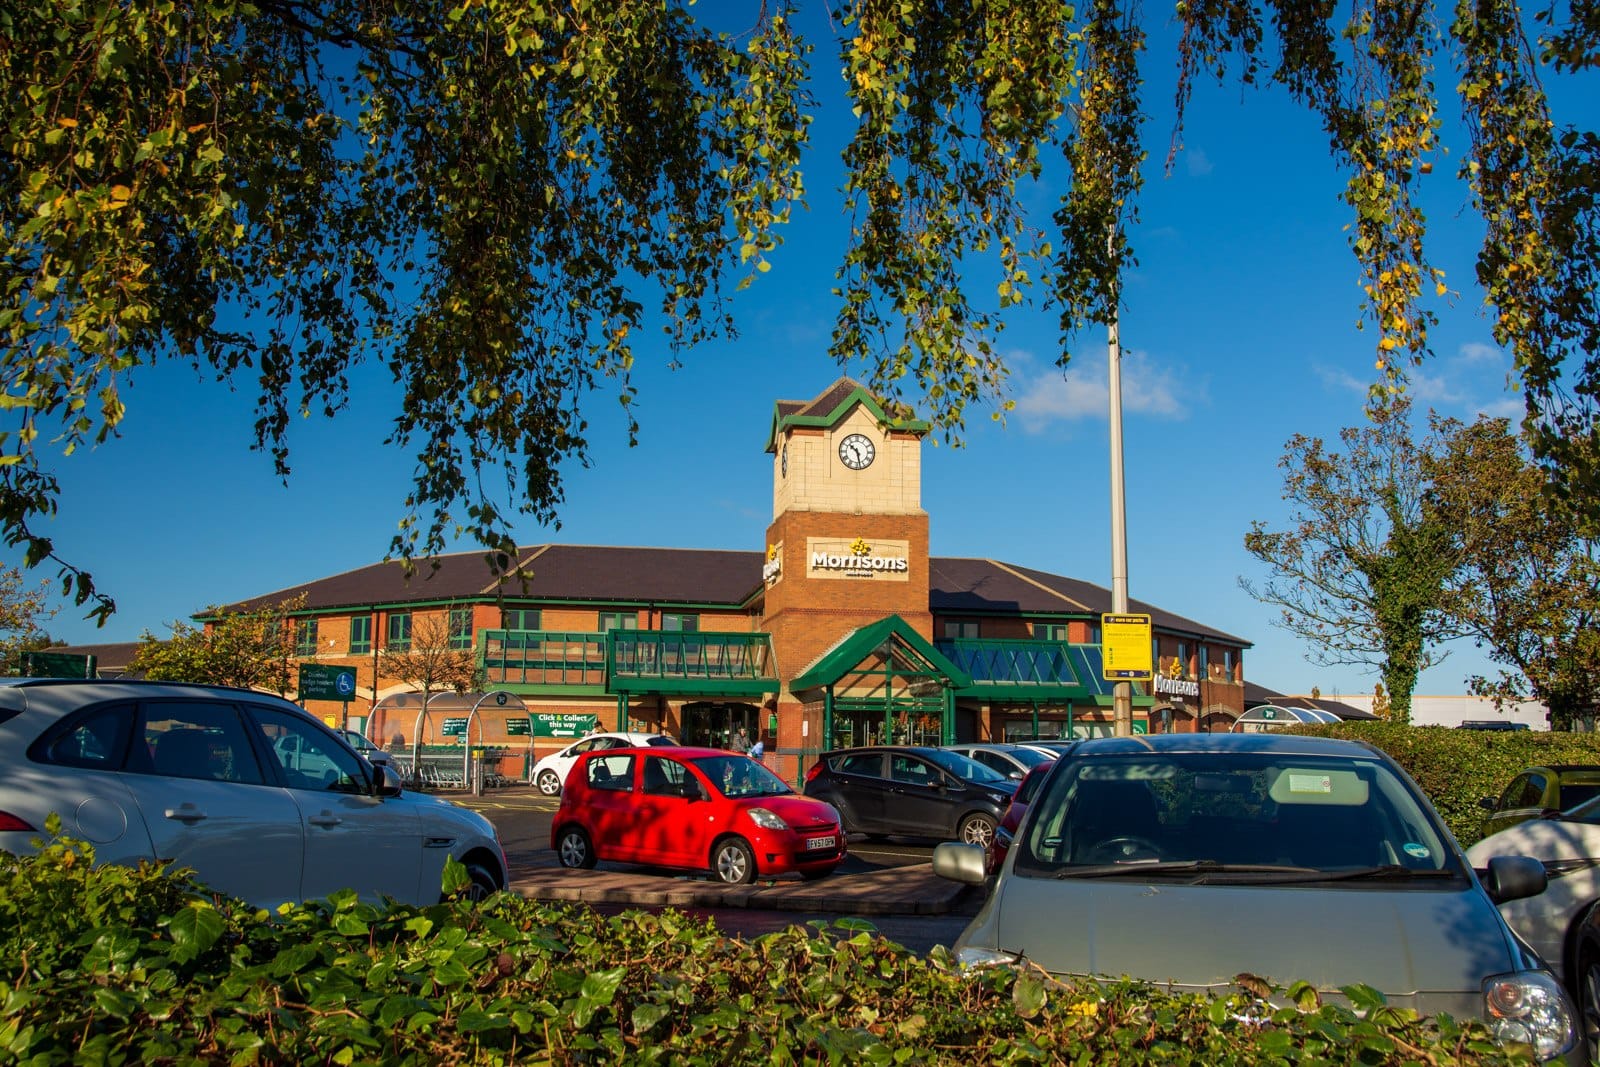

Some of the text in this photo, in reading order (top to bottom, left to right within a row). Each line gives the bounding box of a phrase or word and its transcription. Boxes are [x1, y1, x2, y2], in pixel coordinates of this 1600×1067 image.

[812, 551, 907, 570] Morrisons
[1153, 673, 1199, 697] Morrisons
[563, 714, 587, 722] Collect
[563, 722, 577, 730] way
